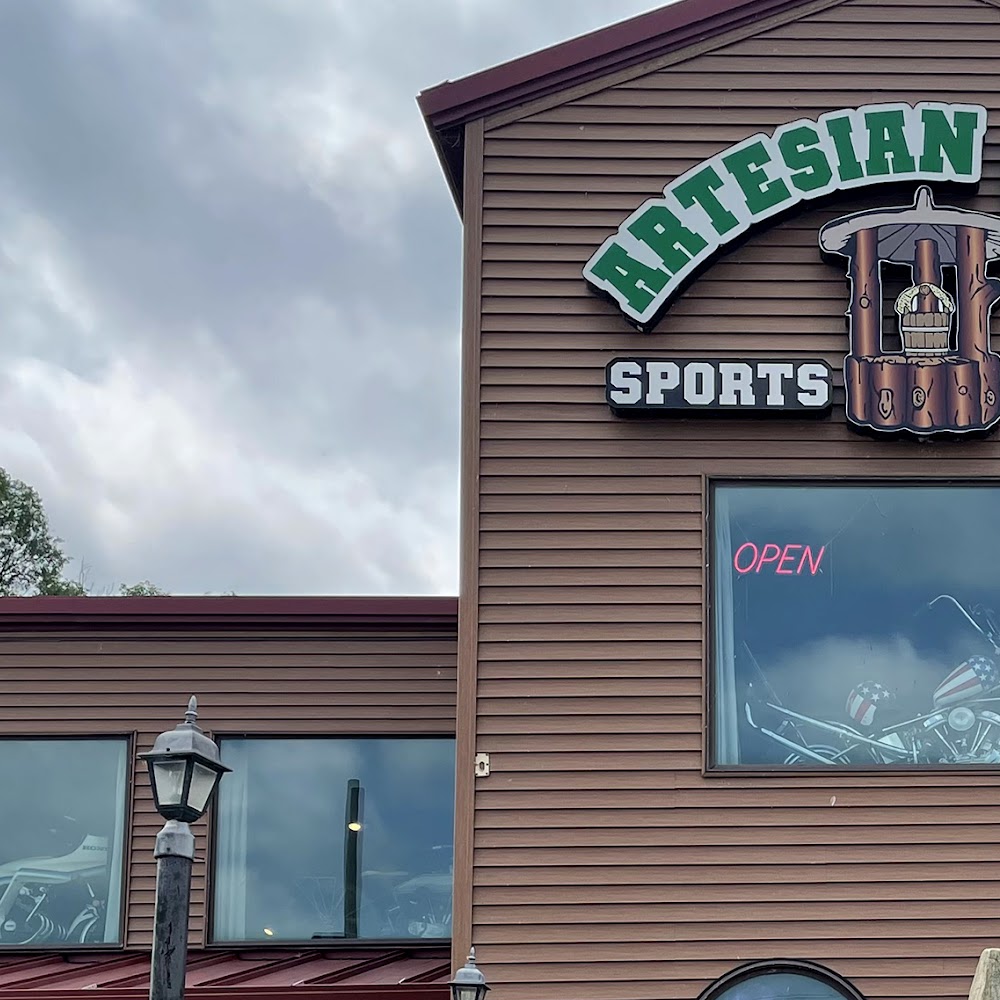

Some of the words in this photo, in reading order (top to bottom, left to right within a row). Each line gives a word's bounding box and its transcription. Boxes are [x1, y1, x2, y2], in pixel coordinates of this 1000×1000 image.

[590, 109, 978, 312] ARTESIAN
[610, 361, 831, 406] SPORTS
[733, 542, 826, 576] OPEN
